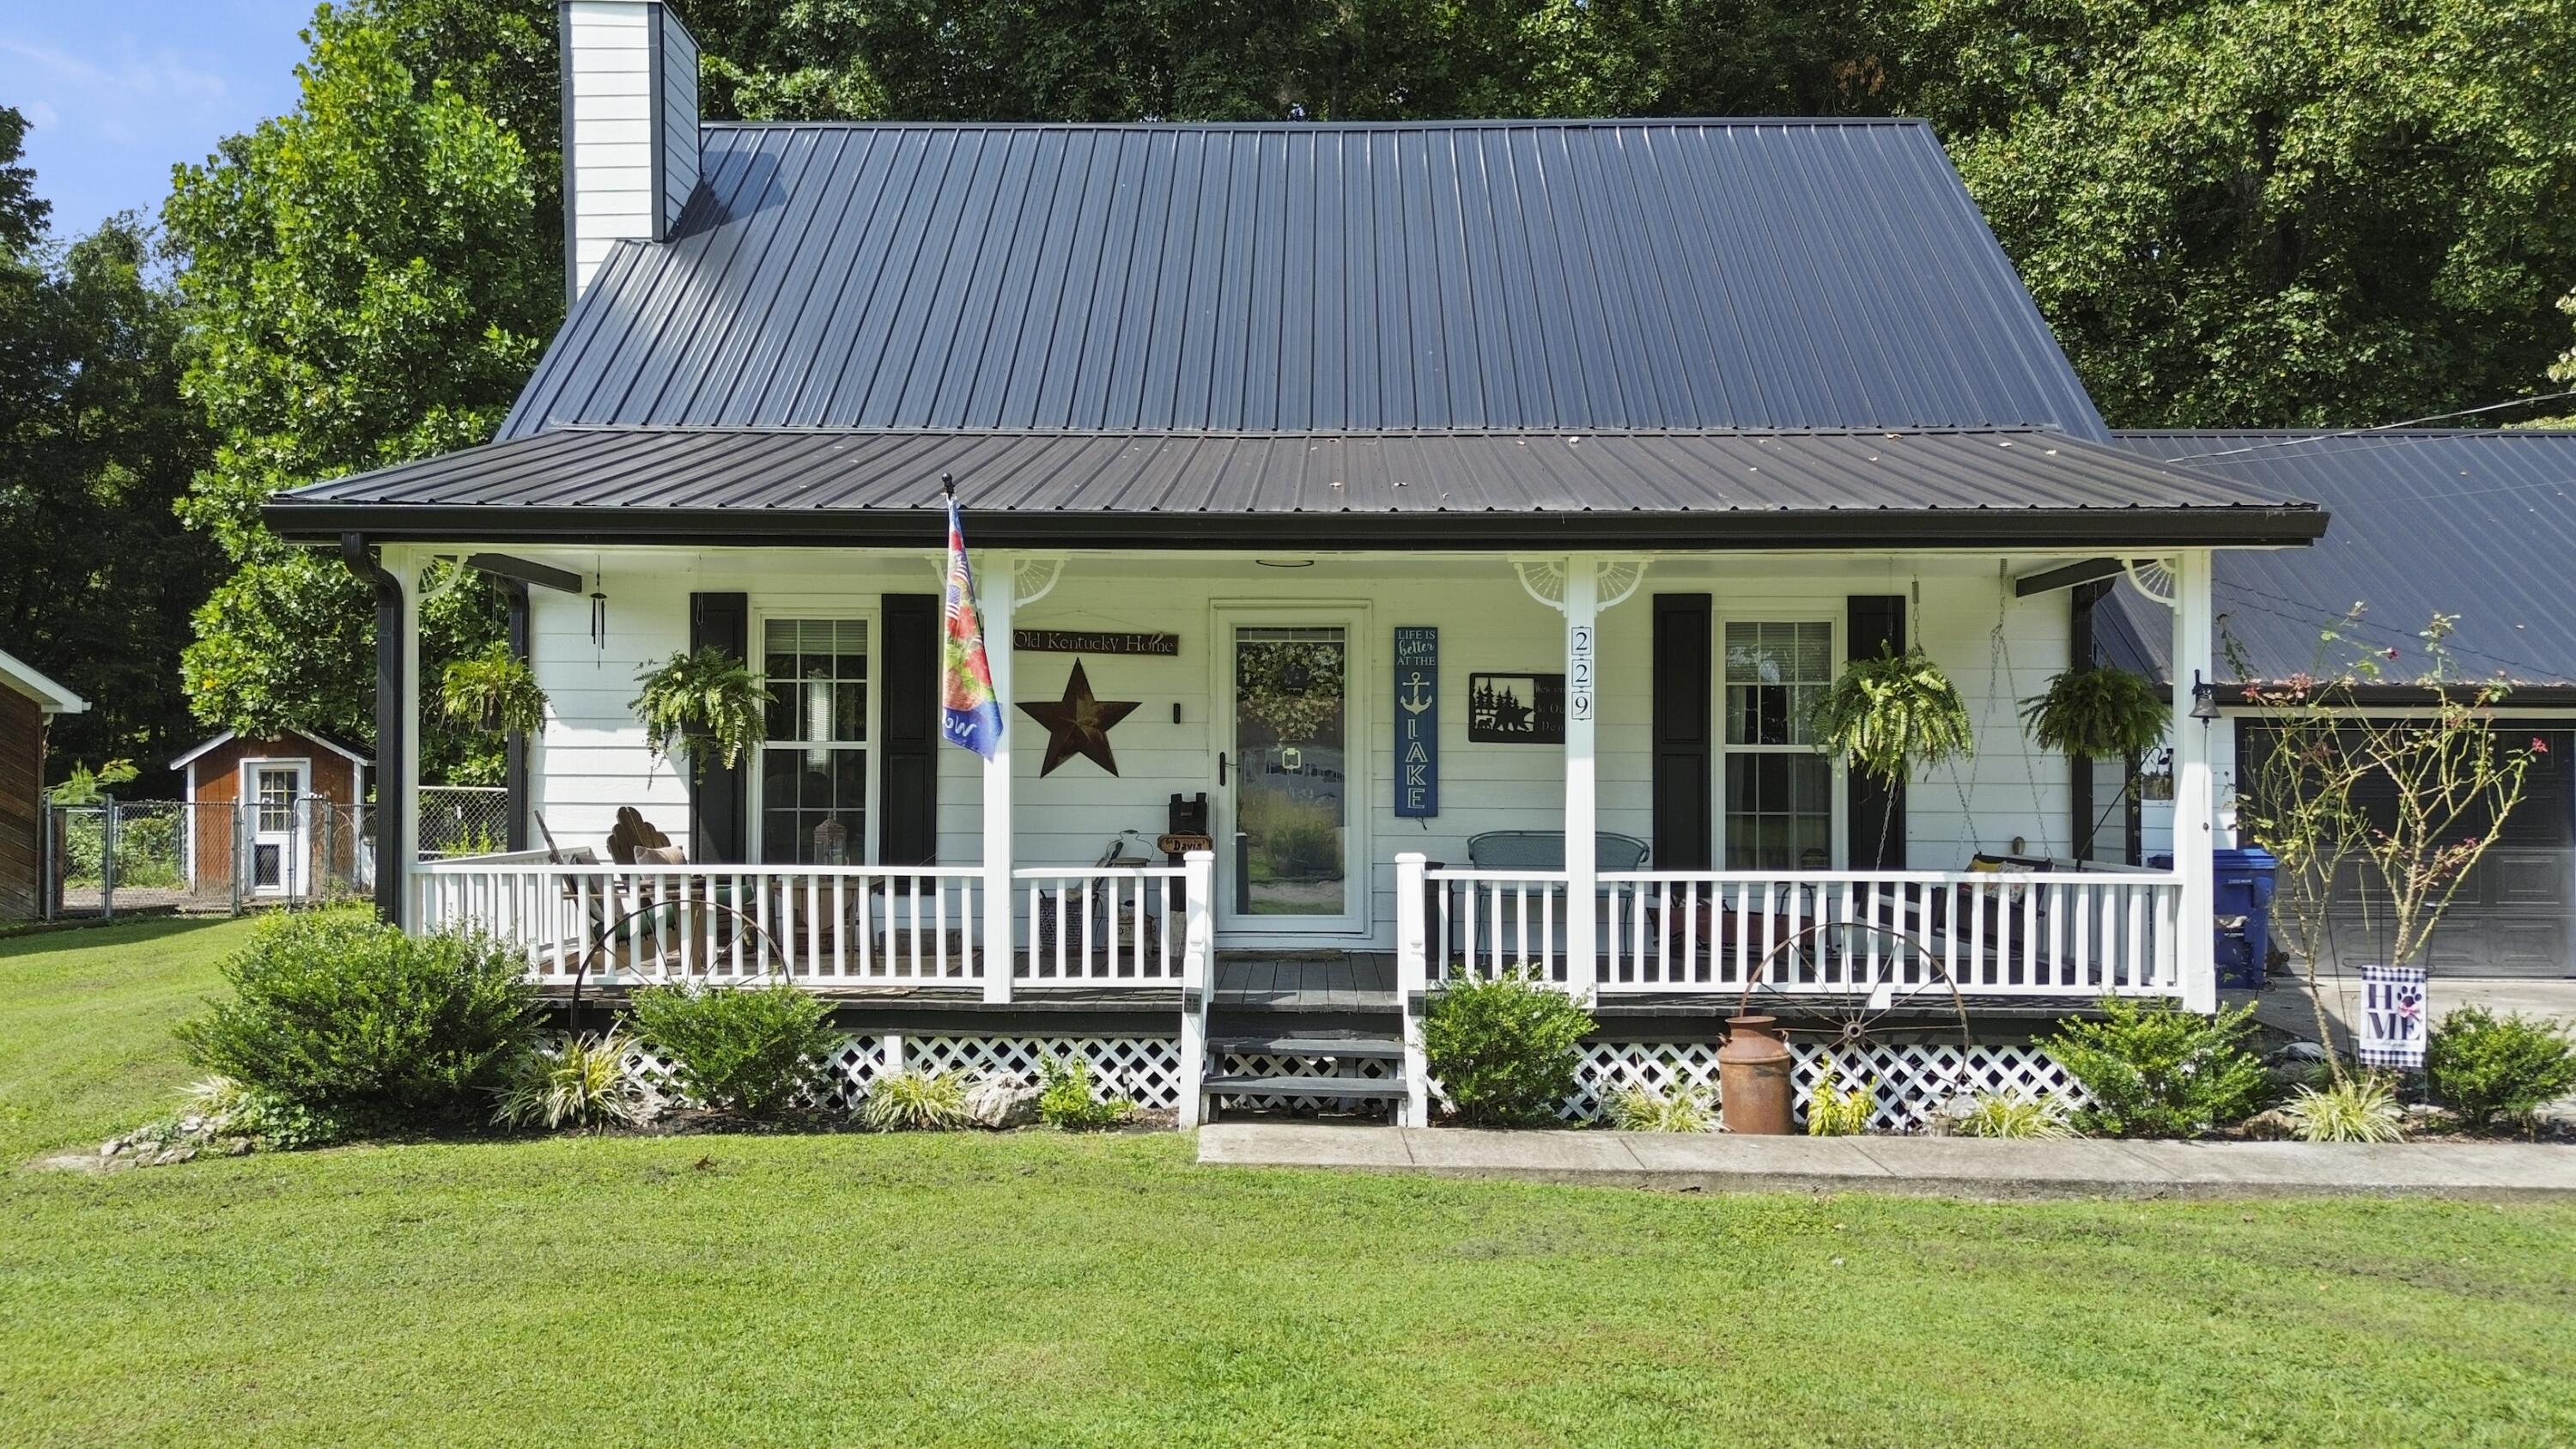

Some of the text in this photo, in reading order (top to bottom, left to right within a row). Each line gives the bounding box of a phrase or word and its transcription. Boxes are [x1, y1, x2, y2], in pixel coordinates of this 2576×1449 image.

[1013, 631, 1174, 653] Old Kentucky Home
[1398, 630, 1436, 640] LIFE IS
[1399, 639, 1435, 656] better
[1397, 656, 1436, 666] AT THE
[1575, 632, 1589, 715] 229
[1405, 719, 1429, 809] LAKE
